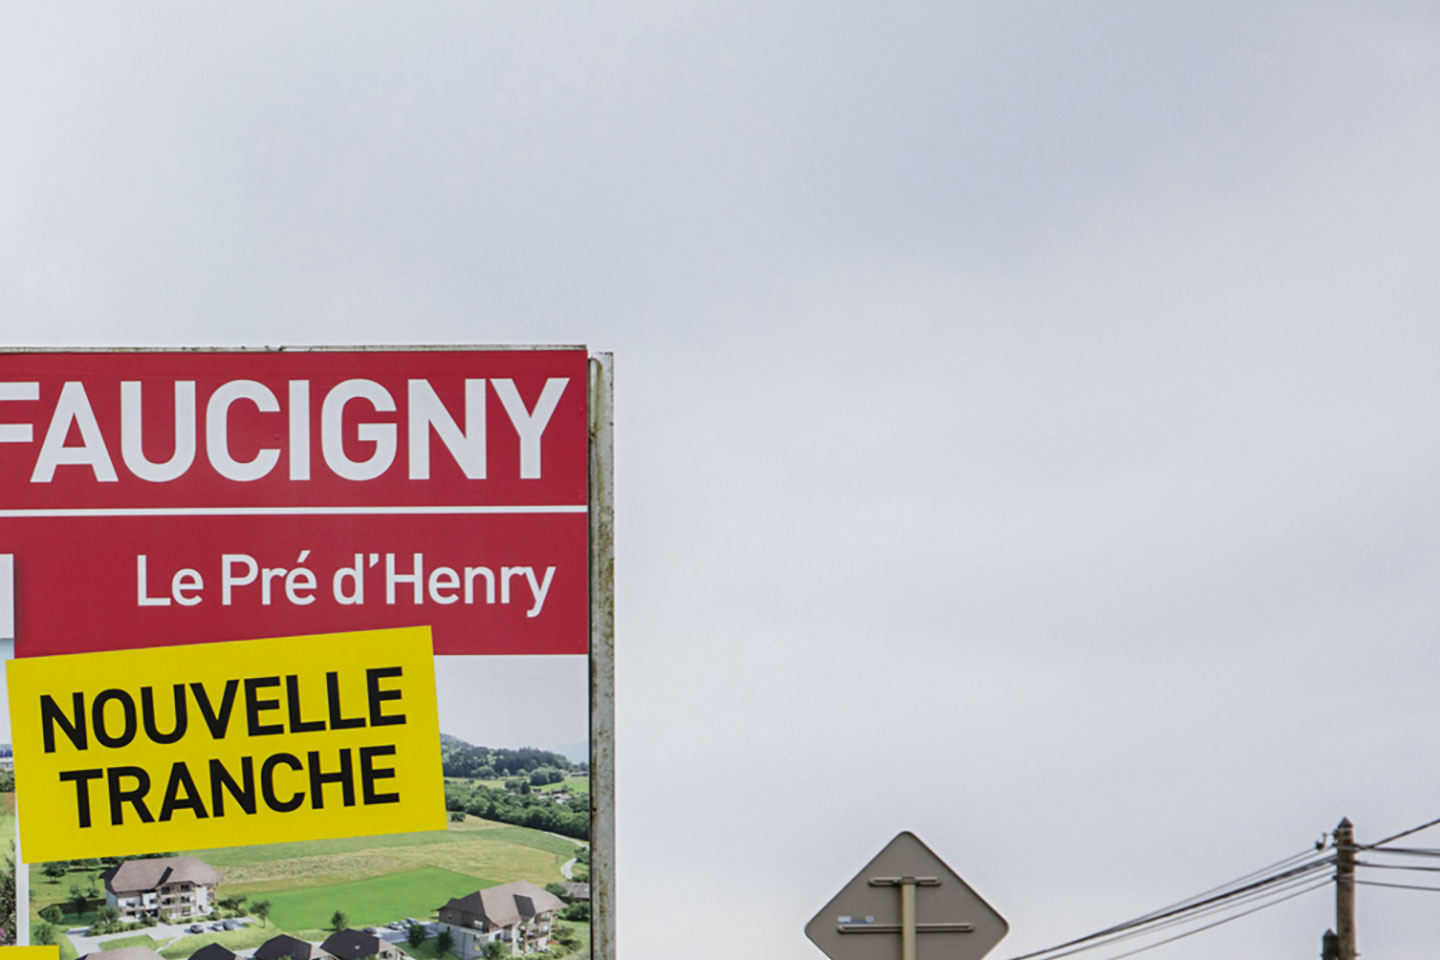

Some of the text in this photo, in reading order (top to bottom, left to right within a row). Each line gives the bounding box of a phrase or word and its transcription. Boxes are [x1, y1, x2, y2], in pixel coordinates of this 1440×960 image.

[137, 549, 556, 619] Le Pré d'Henry
[39, 665, 408, 754] NOUVELLE
[59, 744, 401, 829] TRANCHE
